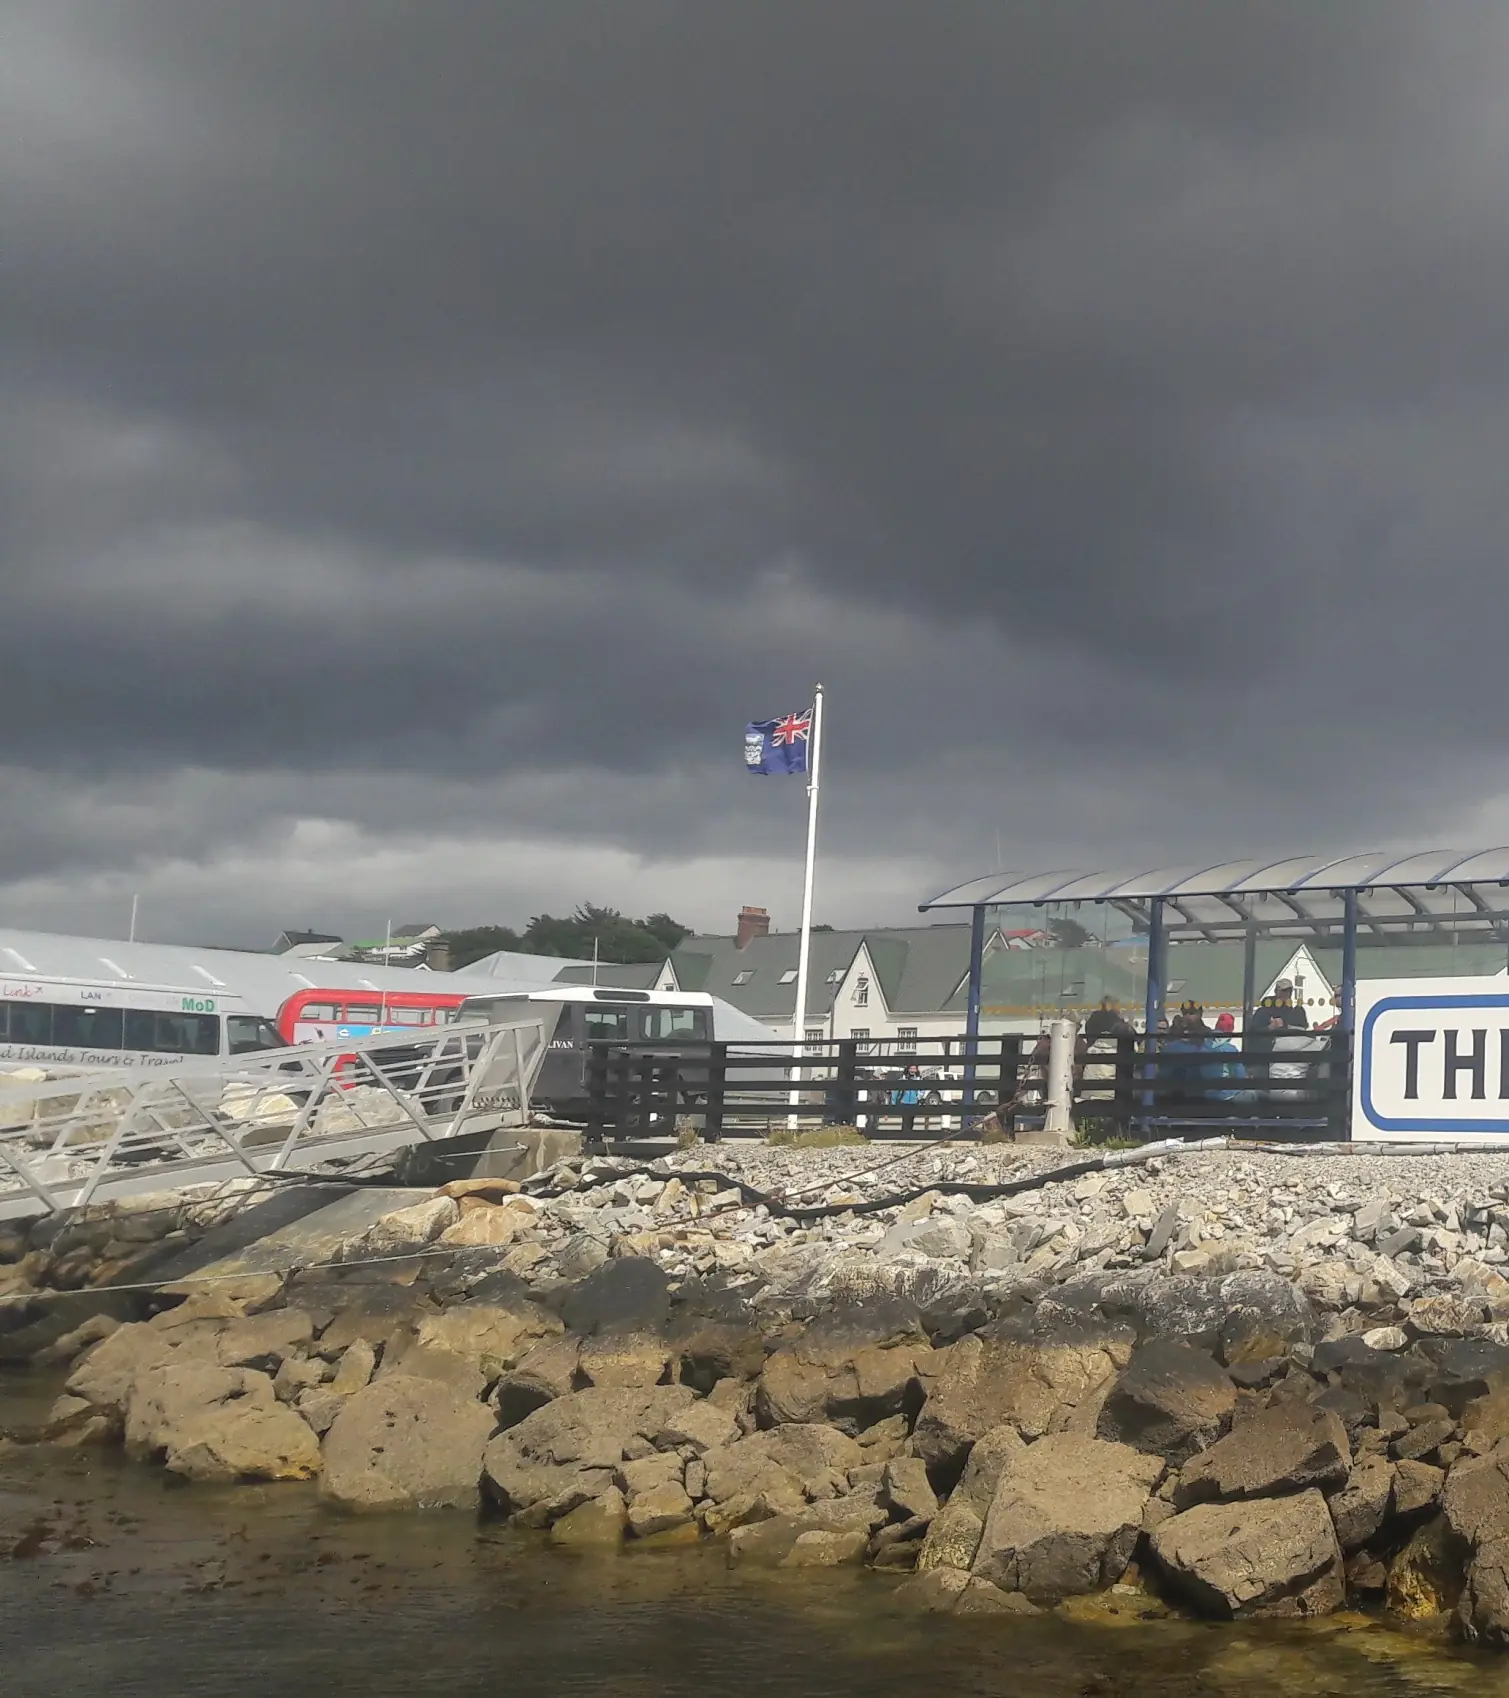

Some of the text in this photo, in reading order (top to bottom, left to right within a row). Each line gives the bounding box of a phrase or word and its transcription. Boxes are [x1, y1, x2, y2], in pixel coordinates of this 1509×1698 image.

[182, 997, 215, 1012] MoD
[18, 1047, 75, 1062] Islands
[80, 1051, 118, 1065] Tours
